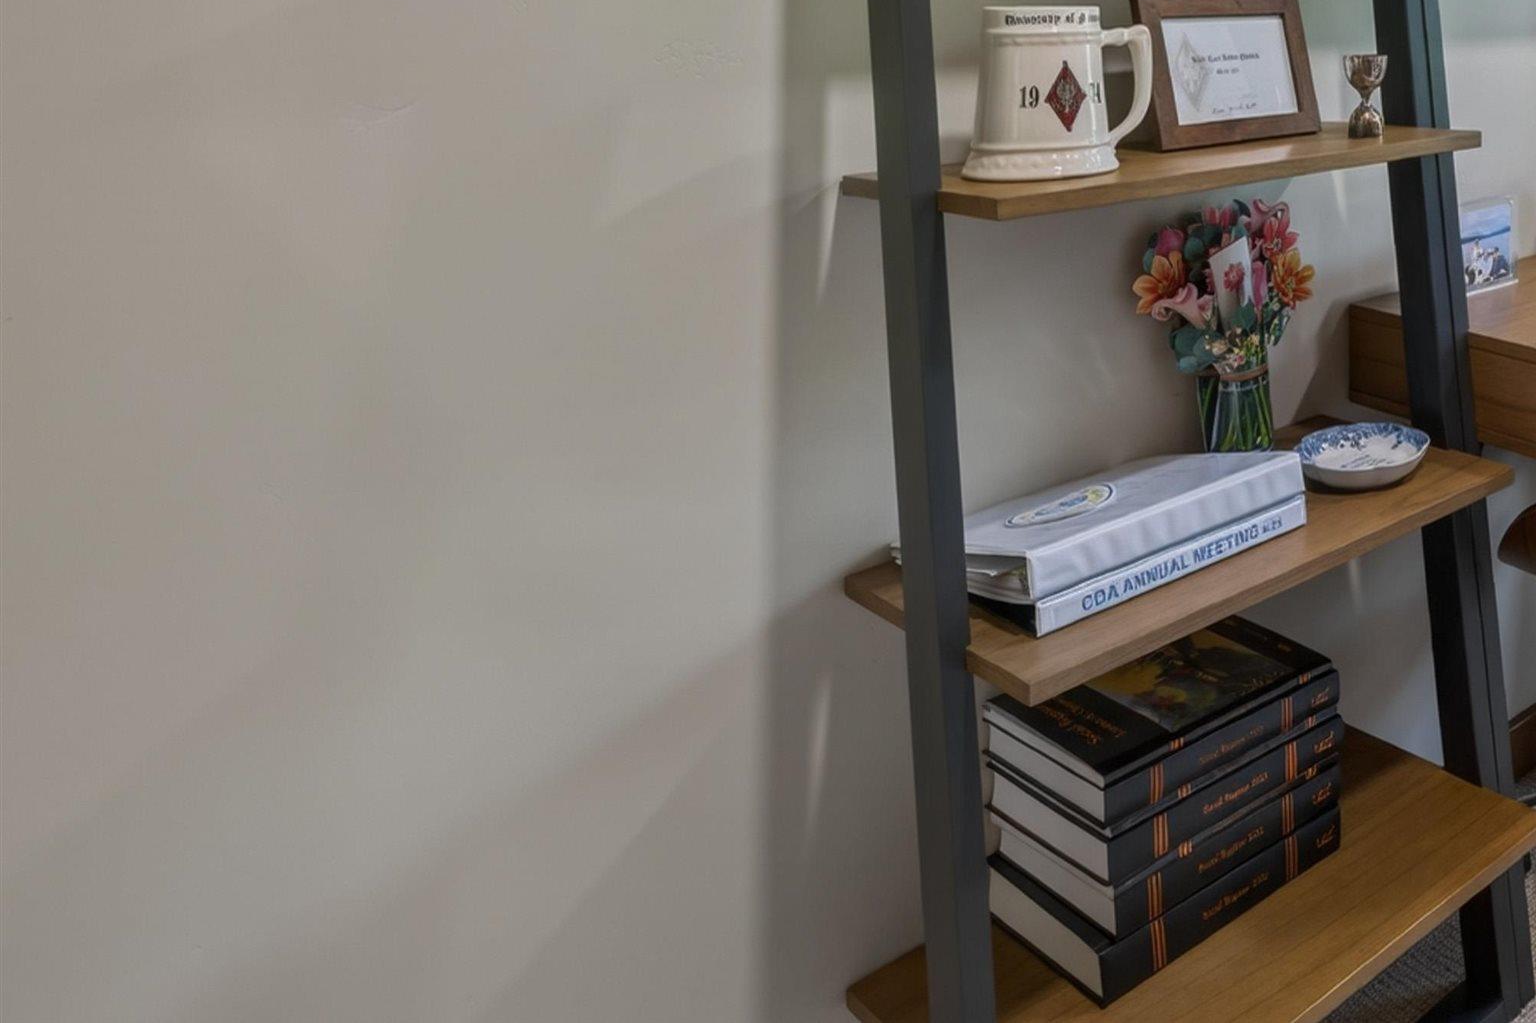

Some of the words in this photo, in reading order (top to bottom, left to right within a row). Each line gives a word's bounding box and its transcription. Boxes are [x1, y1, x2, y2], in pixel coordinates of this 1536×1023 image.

[1019, 85, 1040, 108] 19
[1122, 555, 1189, 594] ANNUAL
[1193, 523, 1260, 564] MEETING
